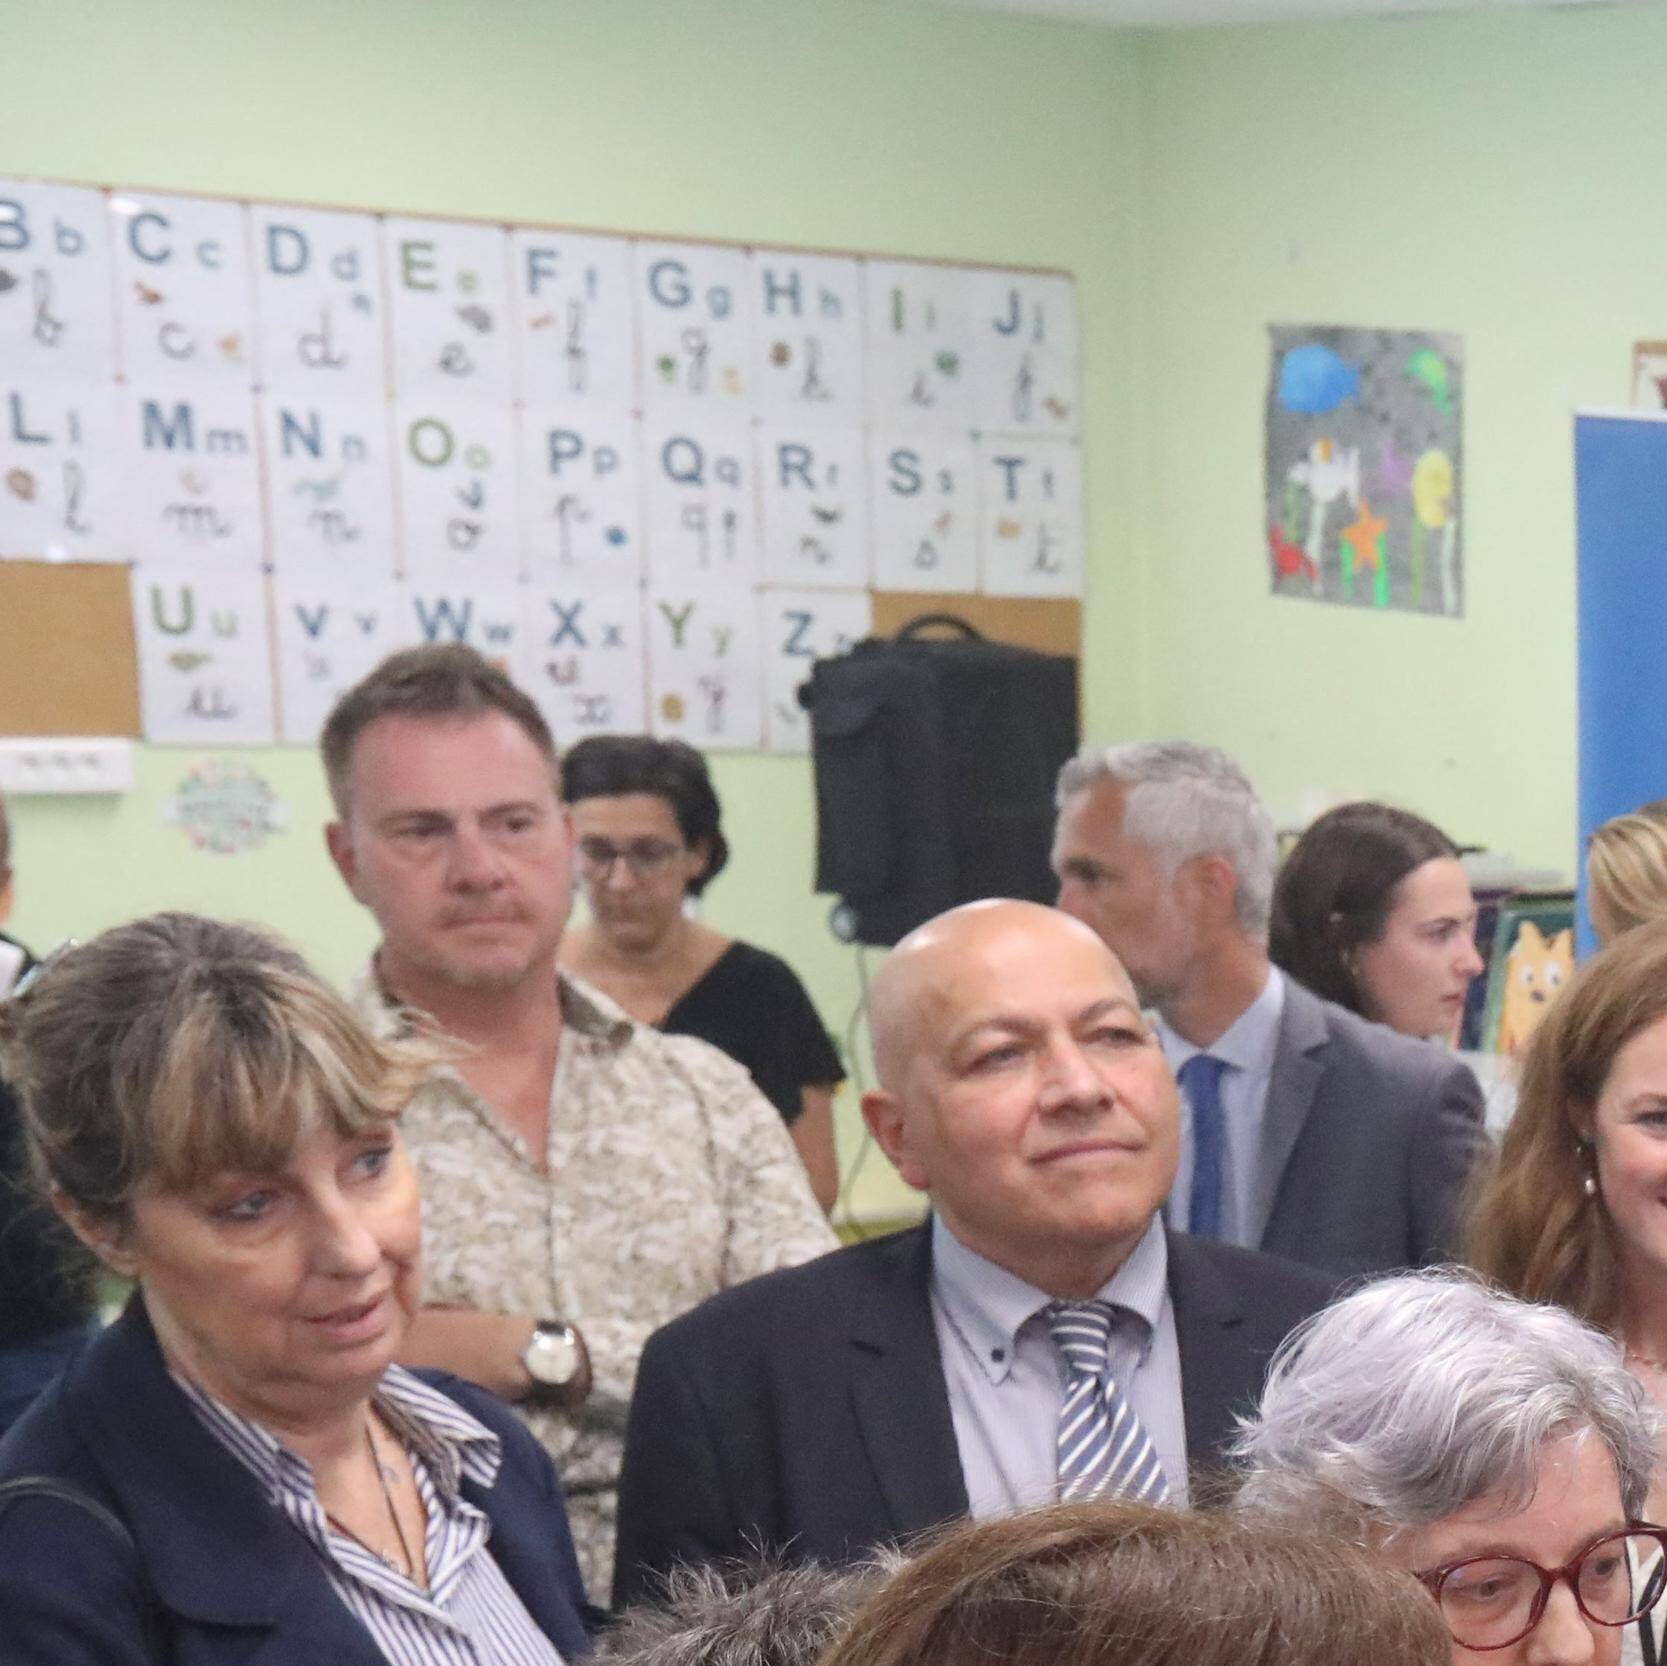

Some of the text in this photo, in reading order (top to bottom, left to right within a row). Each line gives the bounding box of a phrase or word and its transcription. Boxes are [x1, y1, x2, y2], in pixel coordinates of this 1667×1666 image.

[0, 198, 85, 257] B b
[128, 212, 221, 268] C c
[267, 225, 358, 282] D d
[403, 241, 437, 292] E
[527, 248, 560, 294] F
[647, 261, 732, 321] G g
[764, 270, 843, 320] H h
[891, 288, 904, 333] I
[993, 290, 1020, 335] J
[10, 391, 52, 444] L
[143, 400, 248, 454] M m
[281, 409, 367, 461] N n
[408, 417, 491, 469] O o
[549, 430, 619, 477] P p
[662, 436, 702, 486] Q
[778, 445, 816, 490] R
[888, 450, 923, 498] S
[993, 457, 1025, 501] T
[150, 586, 239, 638] U u
[295, 604, 376, 638] V v
[416, 599, 513, 643] W w
[550, 602, 625, 647] X x
[660, 603, 697, 649] Y
[784, 611, 816, 658] Z
